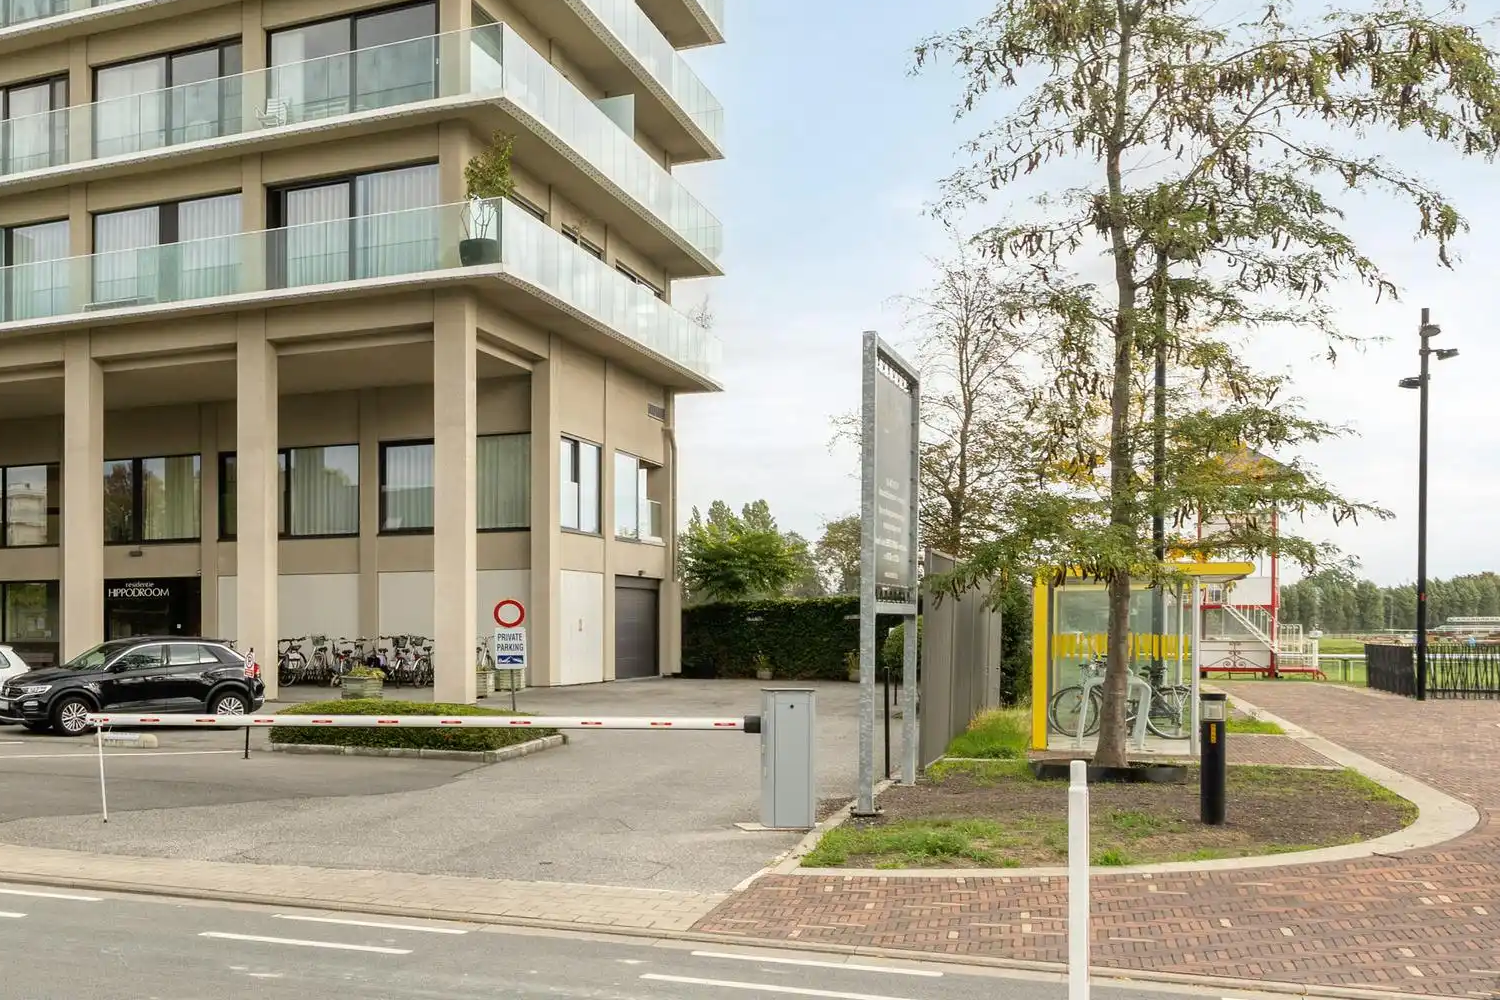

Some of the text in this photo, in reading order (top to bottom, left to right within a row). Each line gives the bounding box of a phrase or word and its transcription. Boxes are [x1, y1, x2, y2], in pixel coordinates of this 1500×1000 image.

[108, 588, 169, 597] HIPPODROOM
[497, 633, 522, 641] PRIVATE
[496, 643, 523, 651] PARKING
